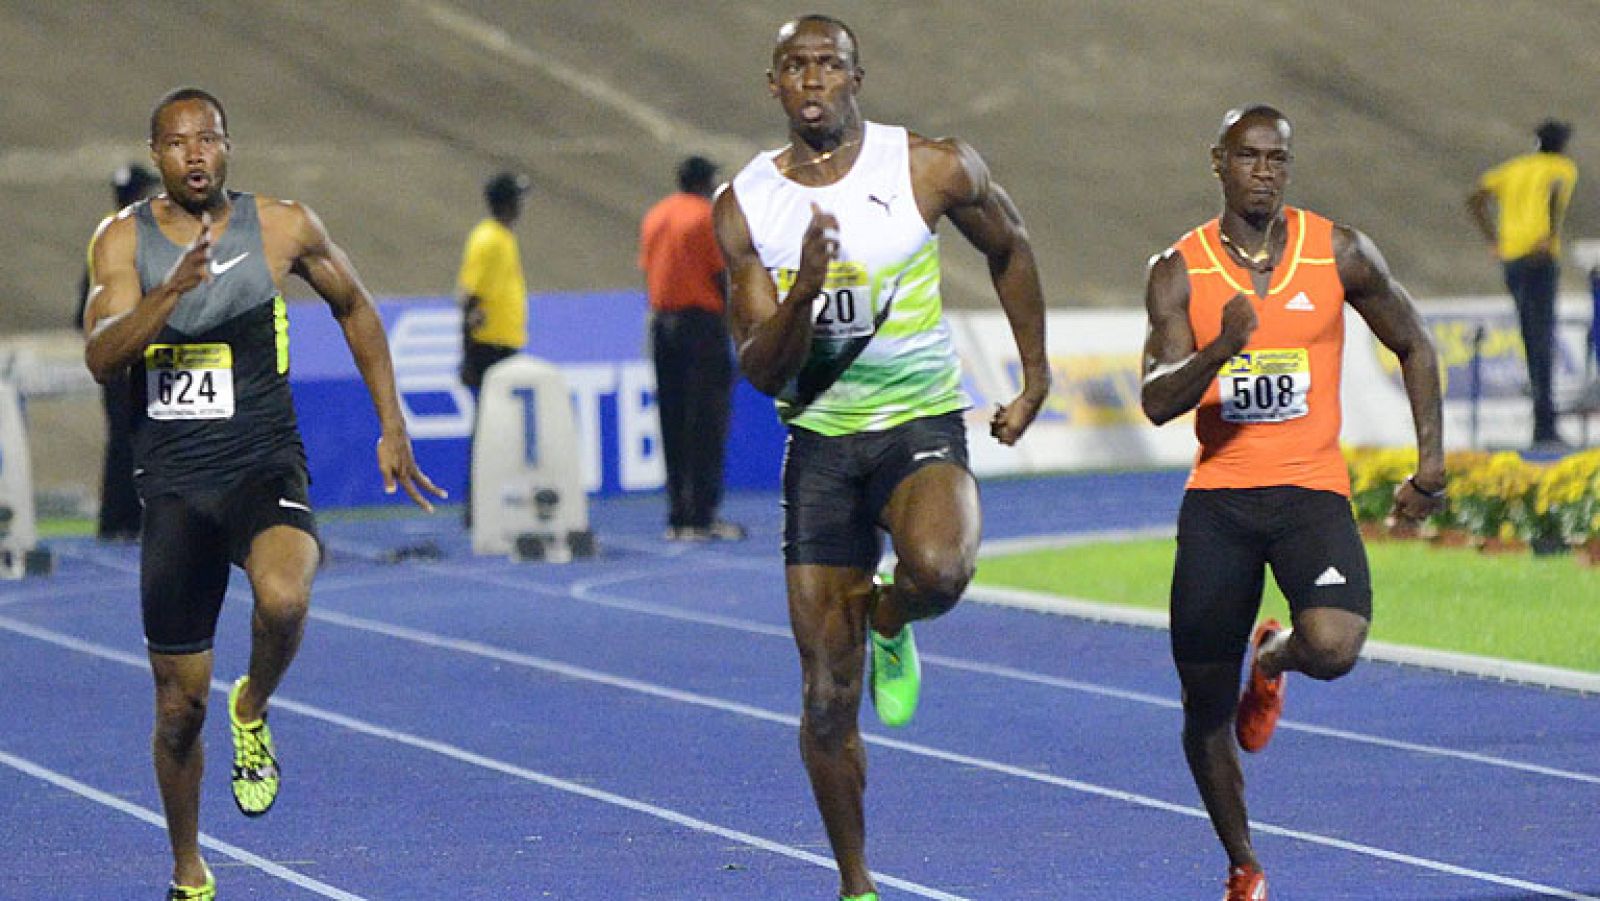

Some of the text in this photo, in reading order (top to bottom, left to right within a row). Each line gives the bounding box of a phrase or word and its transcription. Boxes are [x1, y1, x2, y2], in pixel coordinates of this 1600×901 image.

[158, 370, 217, 405] 624
[1232, 375, 1293, 410] 508
[511, 387, 538, 469] 1
